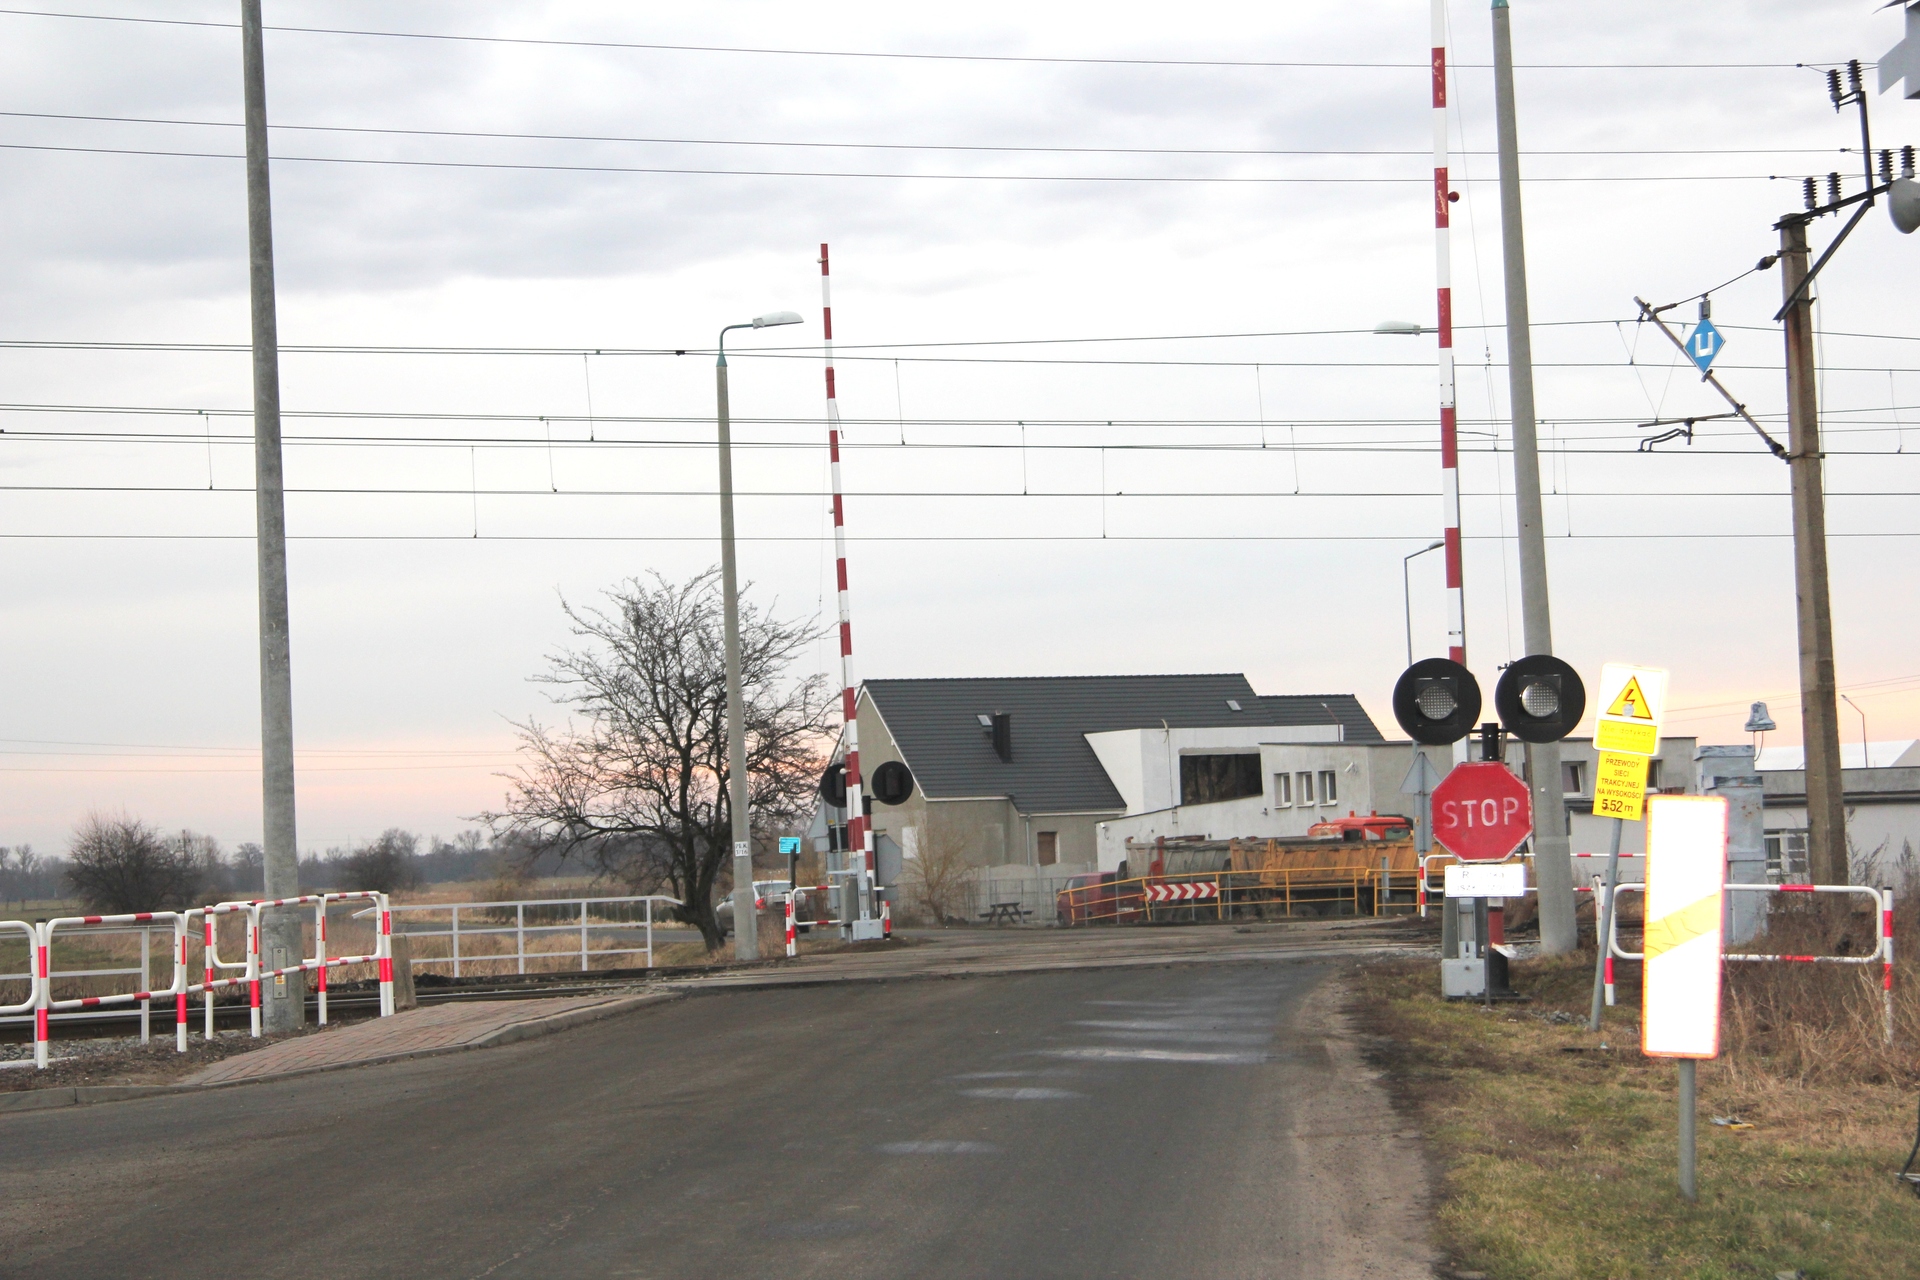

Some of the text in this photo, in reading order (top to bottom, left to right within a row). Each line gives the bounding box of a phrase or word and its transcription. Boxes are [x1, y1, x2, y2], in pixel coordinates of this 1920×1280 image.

[1606, 758, 1640, 768] PRZEWODY
[1614, 769, 1630, 777] SIECI
[1601, 777, 1640, 789] TRAKCYJNEJ
[1598, 788, 1642, 799] NA WYSOKOŚCI
[1442, 797, 1519, 829] STOP
[1624, 804, 1634, 812] m
